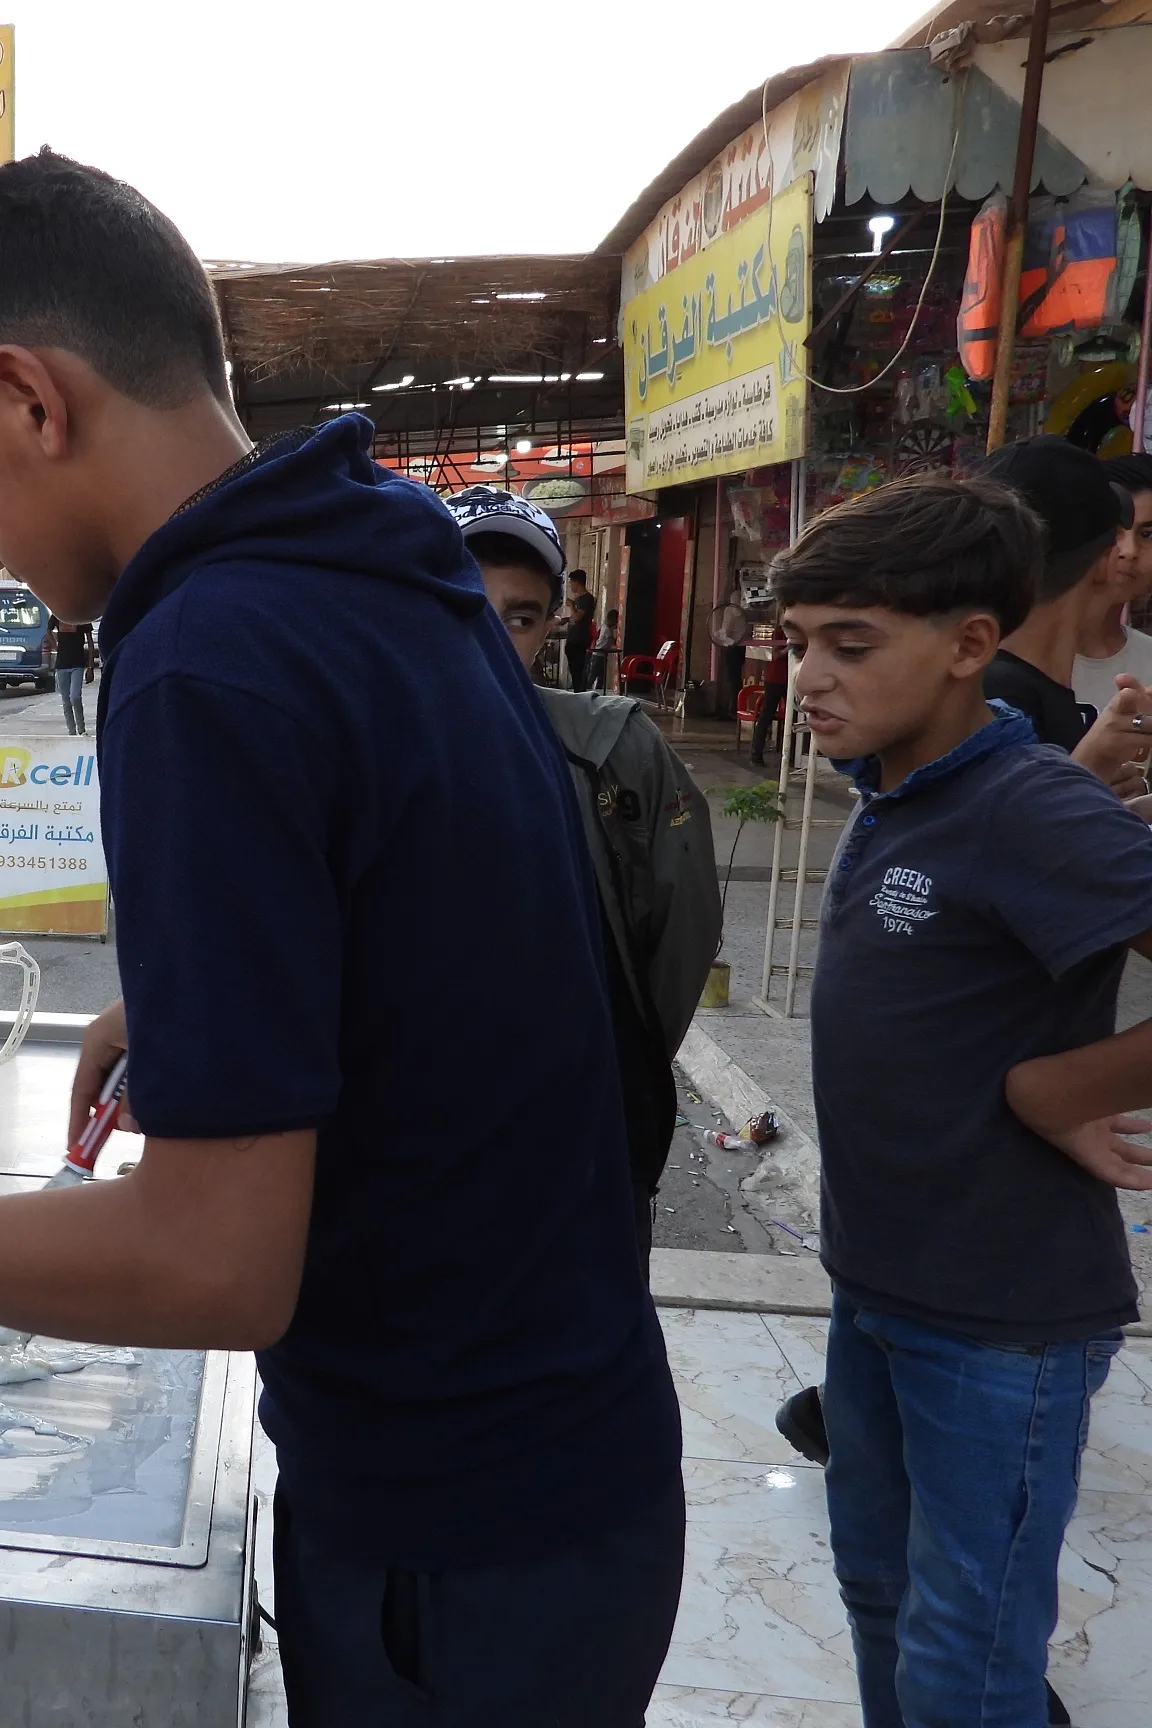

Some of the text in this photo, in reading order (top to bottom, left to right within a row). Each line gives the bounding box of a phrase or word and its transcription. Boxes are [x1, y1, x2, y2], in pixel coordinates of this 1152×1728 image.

[639, 244, 779, 398] مكتبة الفرقان
[742, 375, 771, 412] قرطاسية
[0, 799, 82, 815] تمتع بالسرعة
[44, 825, 94, 846] مكتبة
[883, 867, 932, 895] CREEKS
[882, 916, 914, 936] 1974
